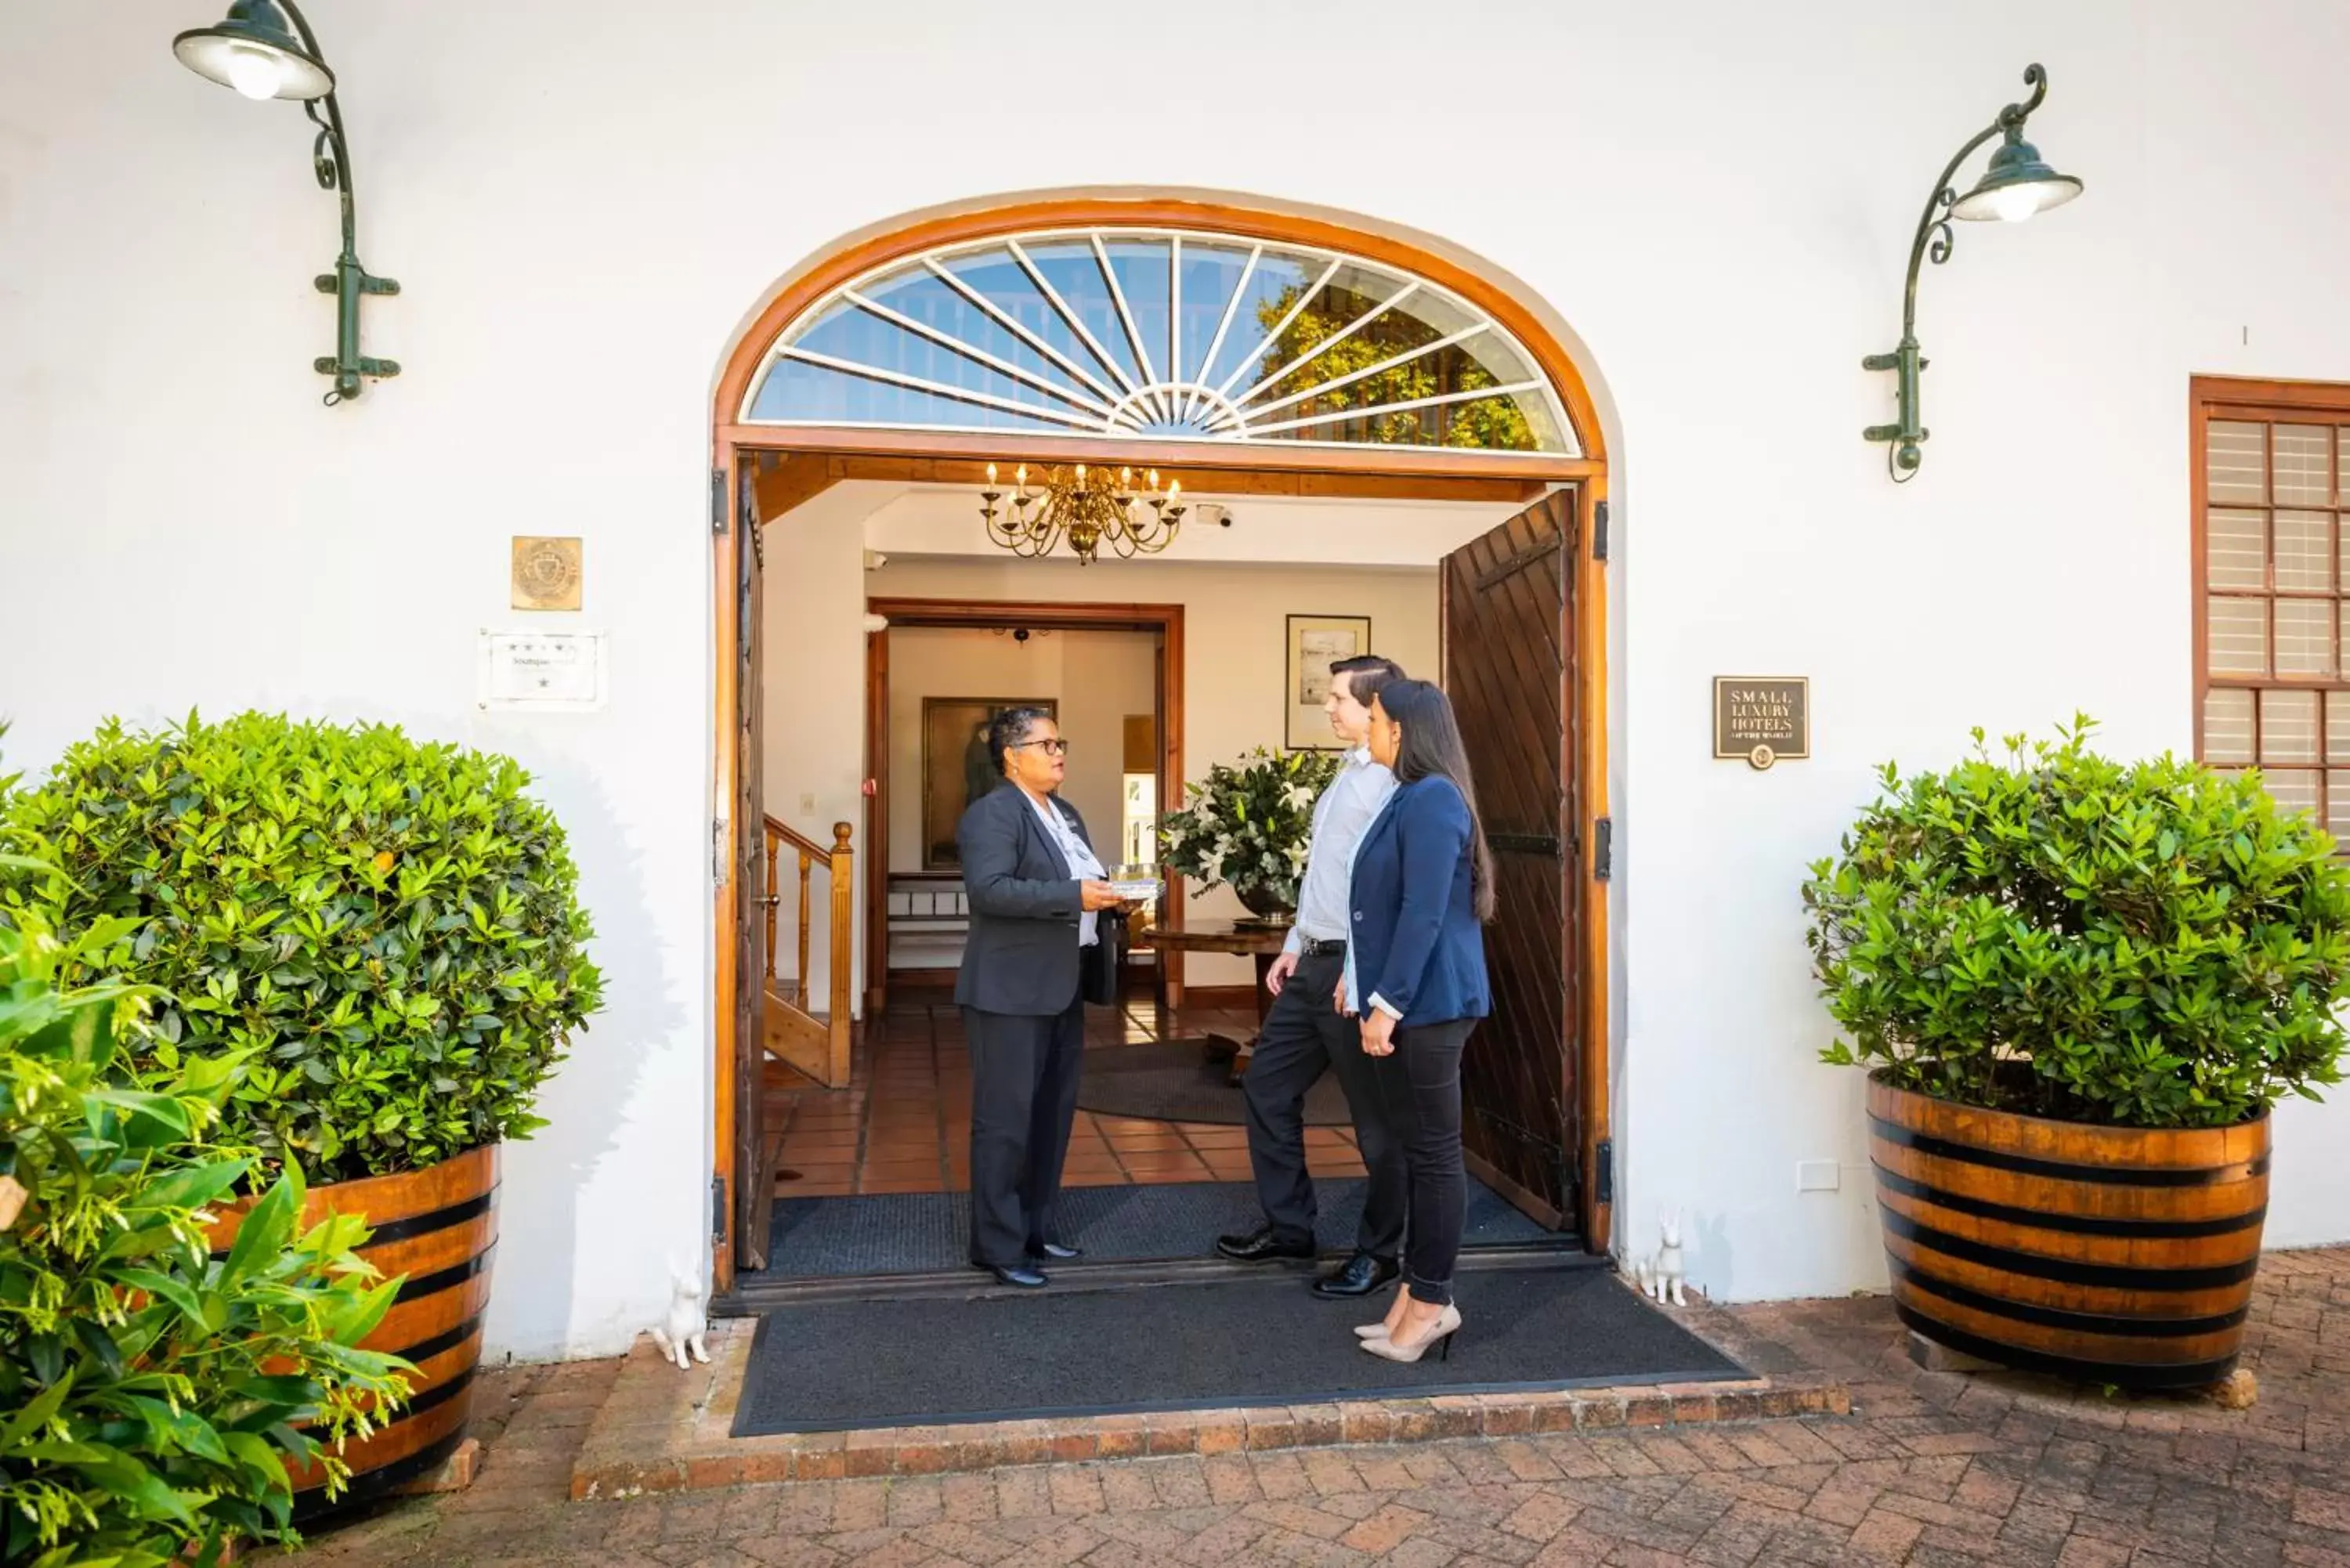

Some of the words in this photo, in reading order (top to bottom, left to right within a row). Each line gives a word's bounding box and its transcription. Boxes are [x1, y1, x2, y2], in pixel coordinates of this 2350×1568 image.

[1730, 690, 1792, 703] SMALL
[1731, 704, 1792, 717] LUXURY
[1731, 718, 1792, 731] HOTELS
